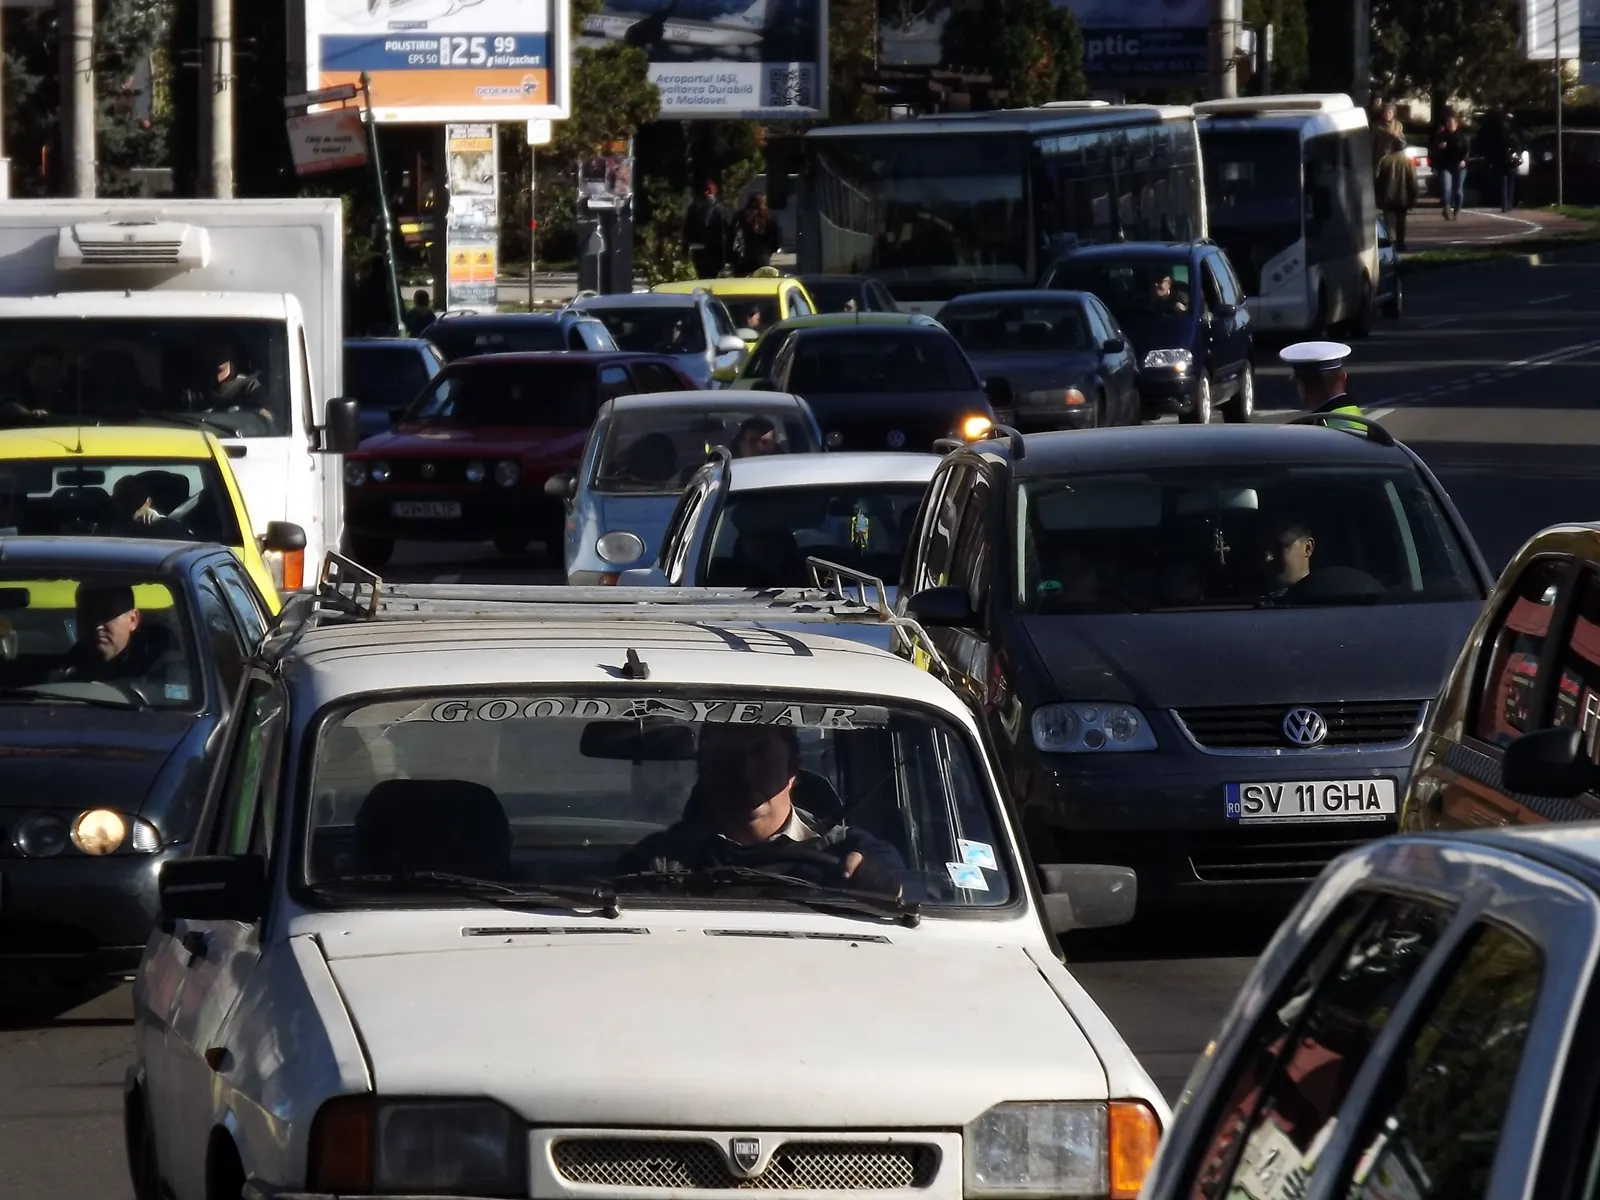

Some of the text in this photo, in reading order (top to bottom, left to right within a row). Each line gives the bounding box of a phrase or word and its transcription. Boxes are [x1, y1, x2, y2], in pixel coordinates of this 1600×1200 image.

[385, 41, 437, 50] POLISTIREN
[1087, 34, 1140, 60] ptic
[408, 54, 437, 64] EPS 50
[656, 74, 713, 84] Aeroportul
[675, 95, 727, 104] Moldovei.
[431, 699, 857, 729] GOOD YEAR
[1243, 783, 1381, 813] SV 11 GHA
[1228, 802, 1240, 813] RO
